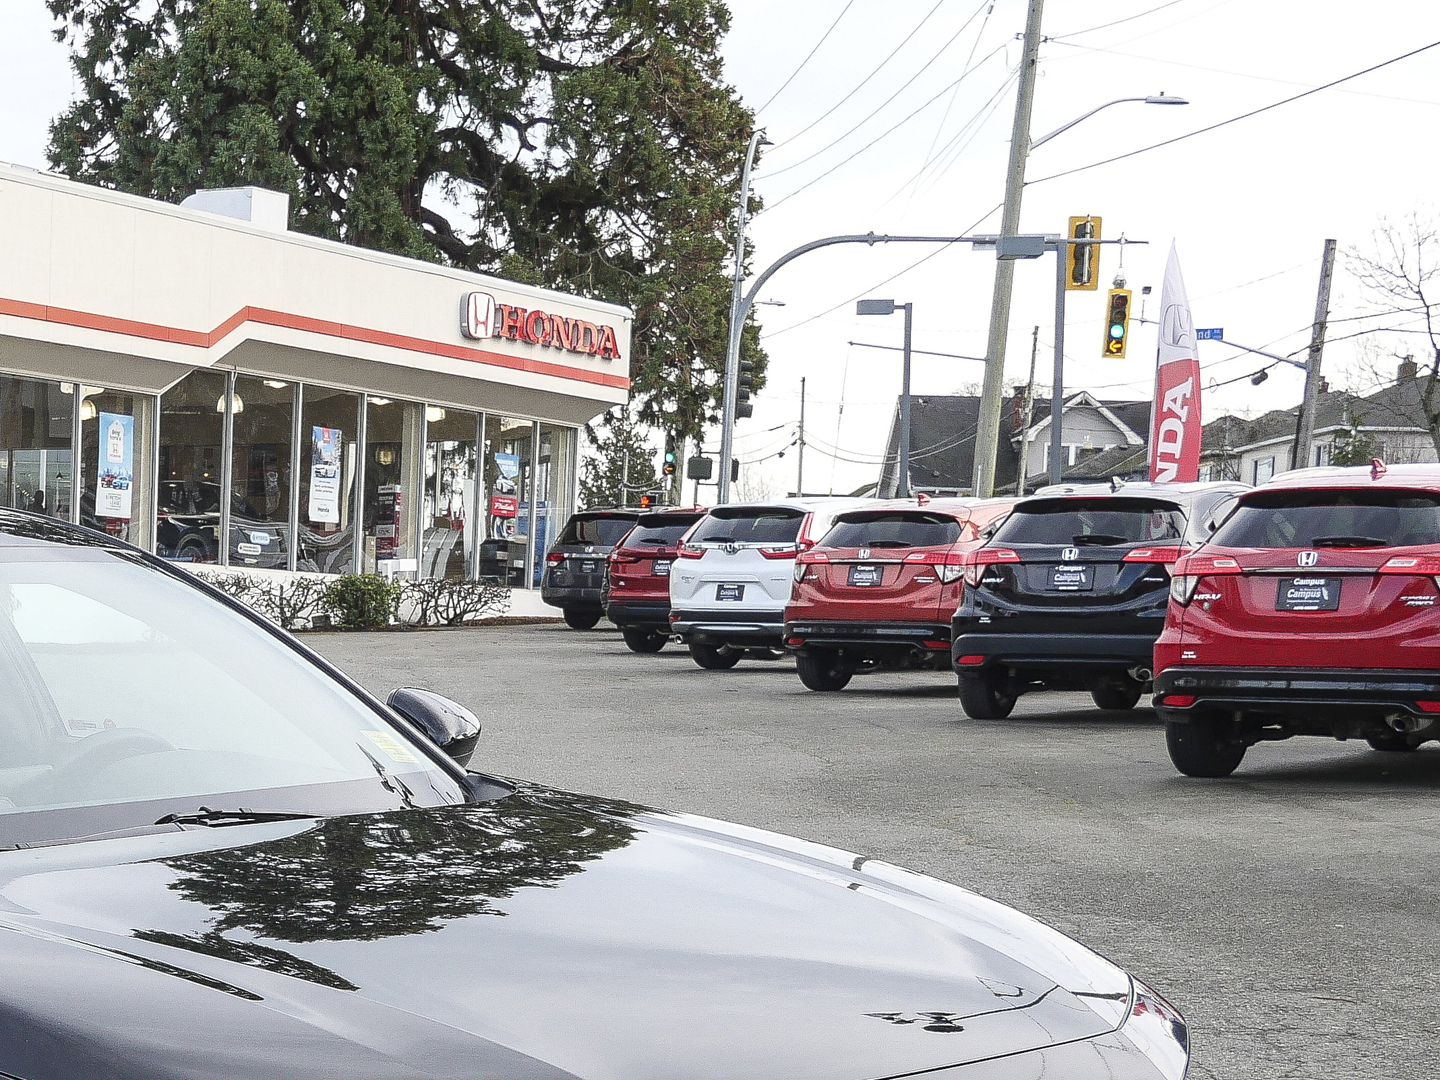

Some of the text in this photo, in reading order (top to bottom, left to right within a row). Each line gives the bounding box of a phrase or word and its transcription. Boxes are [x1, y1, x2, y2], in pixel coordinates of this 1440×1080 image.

[497, 303, 622, 359] HONDA
[1293, 577, 1326, 586] Campus
[1287, 588, 1322, 600] Campus
